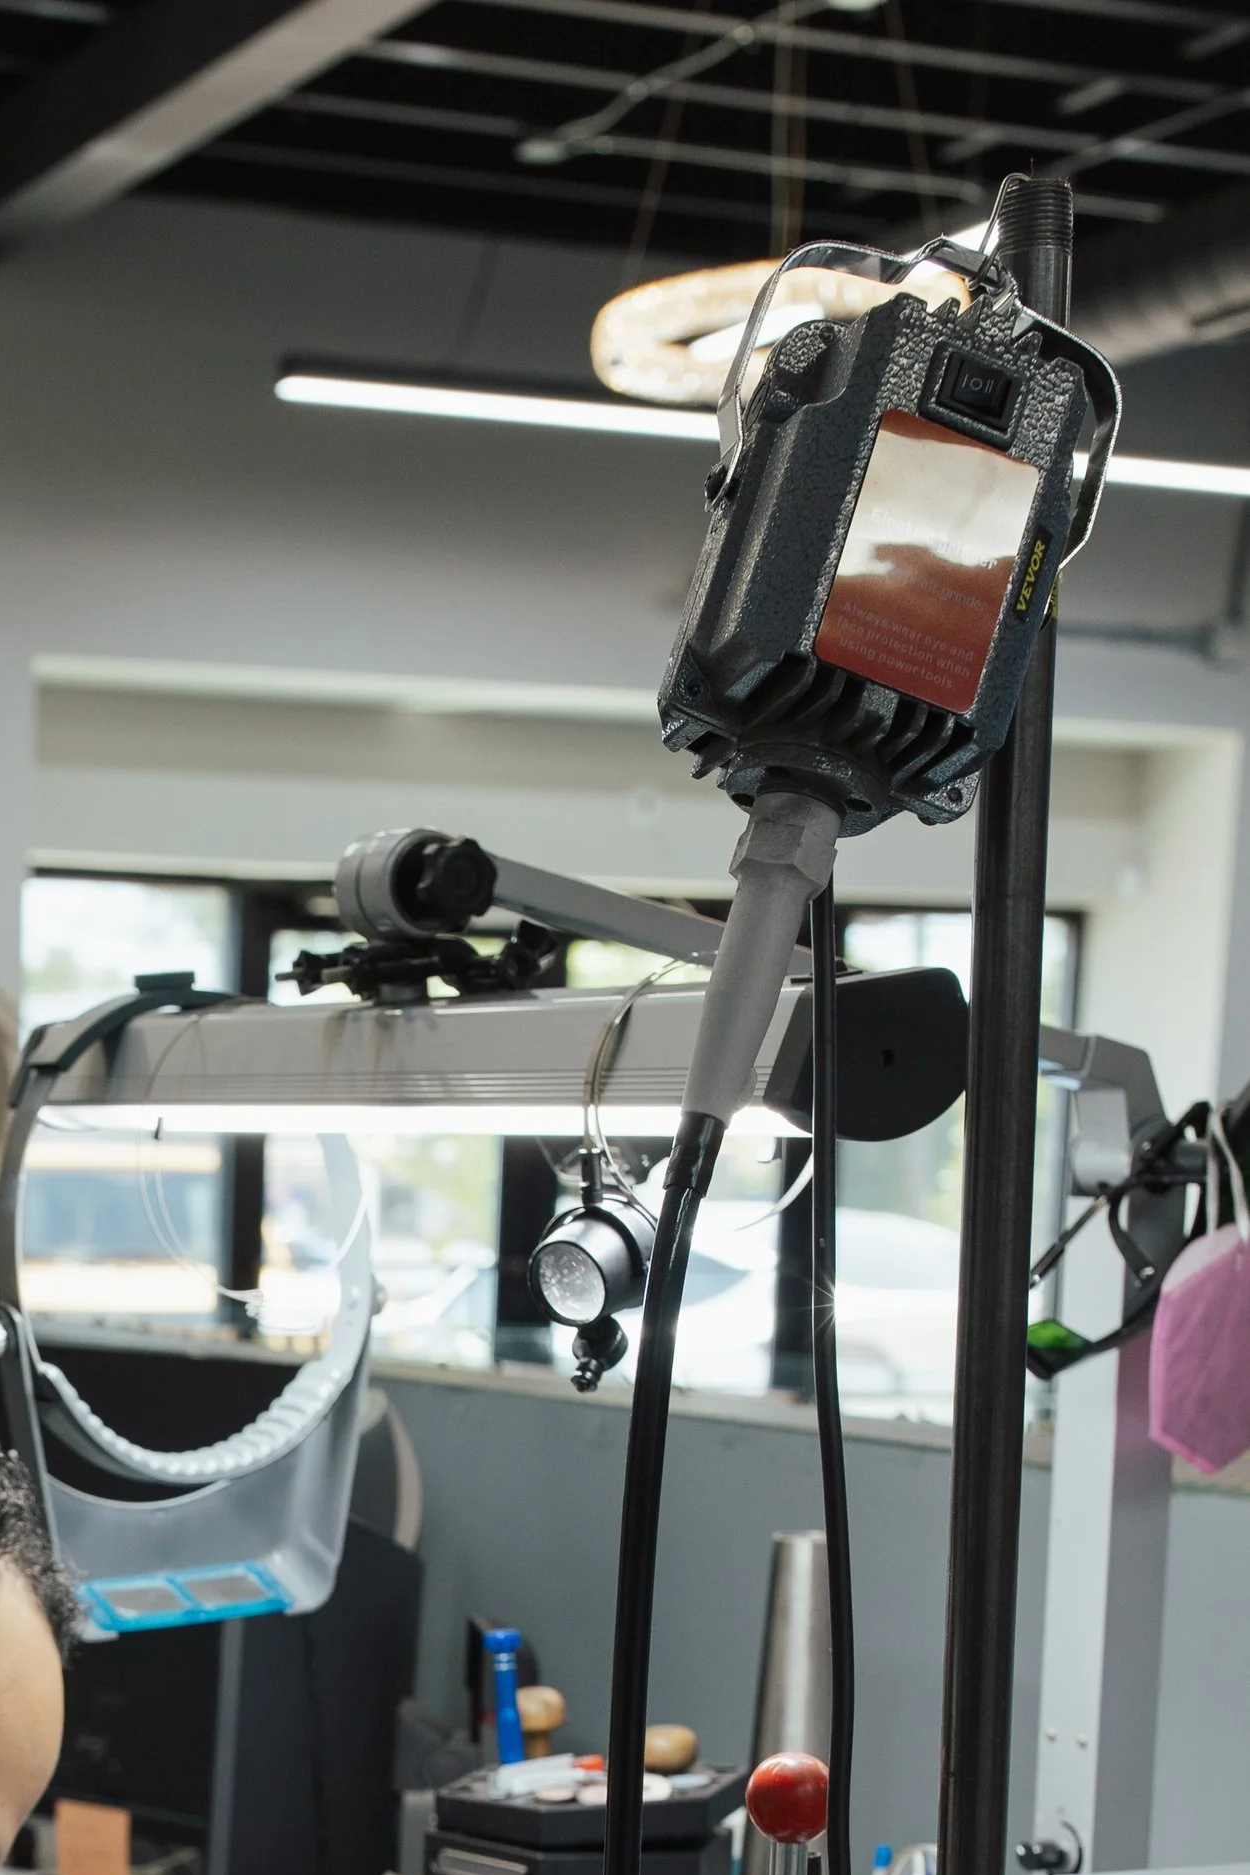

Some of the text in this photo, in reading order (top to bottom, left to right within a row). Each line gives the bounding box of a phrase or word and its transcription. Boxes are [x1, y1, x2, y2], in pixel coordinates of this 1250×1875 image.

[1016, 540, 1046, 612] VEVOR
[839, 638, 876, 661] using
[877, 653, 920, 675] power
[842, 602, 976, 662] Always wear eye and
[866, 630, 934, 663] protection
[936, 656, 971, 677] when
